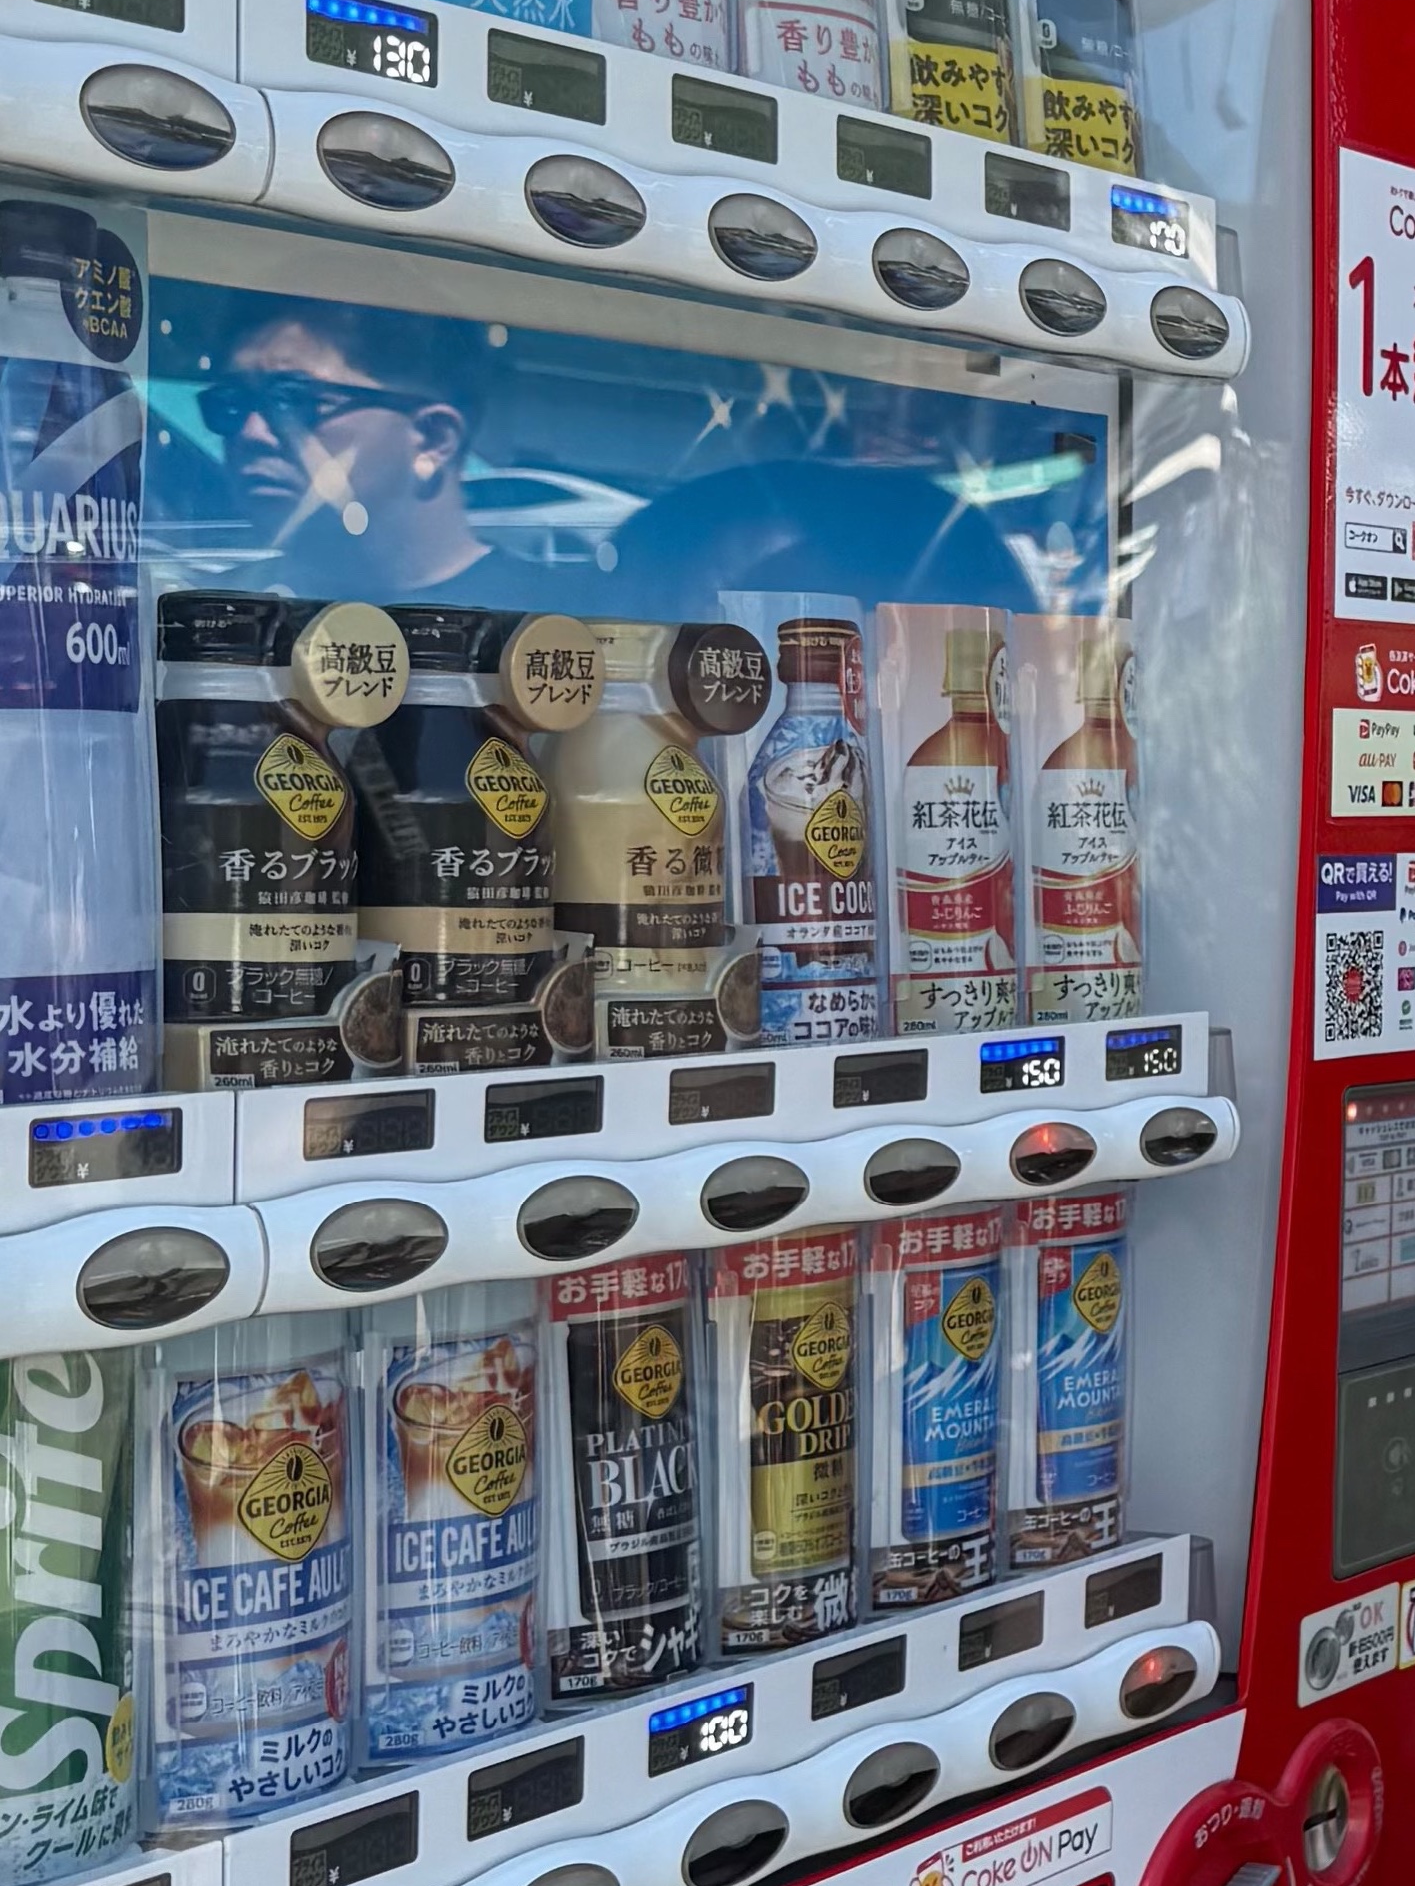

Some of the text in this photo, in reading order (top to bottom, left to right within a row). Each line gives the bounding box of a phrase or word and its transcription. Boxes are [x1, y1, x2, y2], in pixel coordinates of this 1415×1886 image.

[320, 642, 397, 675] 高級豆
[525, 648, 595, 682] 高級豆
[324, 676, 394, 699] ブレンド
[703, 679, 764, 705] ブレンド
[911, 800, 999, 830] 紅茶花伝
[1047, 801, 1128, 830] 紅茶花伝
[0, 990, 144, 1037] 水より優れた
[8, 1036, 139, 1078] 水分補給
[215, 1036, 340, 1058] 淹れたてのような
[259, 1058, 336, 1079] 香りとコク
[1020, 1058, 1060, 1086] 150
[452, 1445, 526, 1476] GEORGIA
[245, 1483, 331, 1520] GEORGIA
[394, 1519, 503, 1573] ICE CAFE
[183, 1566, 304, 1623] ICE CAFE
[259, 1728, 334, 1765] ミルクの
[699, 1707, 750, 1753] 100
[228, 1752, 344, 1804] やさしいコク
[1056, 1822, 1100, 1864] Pay
